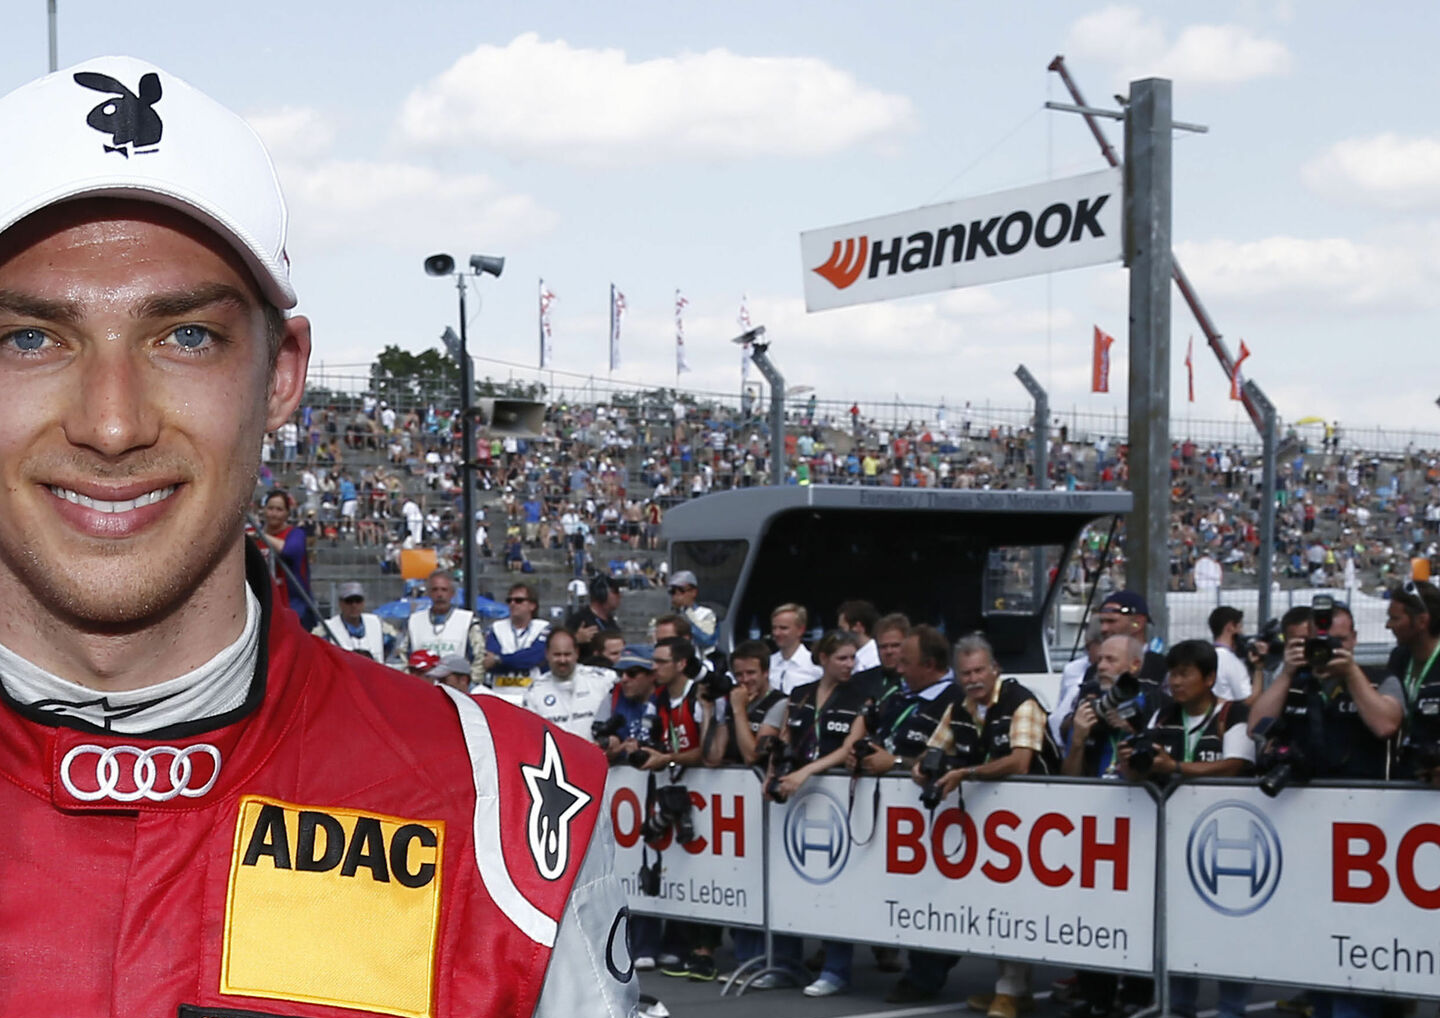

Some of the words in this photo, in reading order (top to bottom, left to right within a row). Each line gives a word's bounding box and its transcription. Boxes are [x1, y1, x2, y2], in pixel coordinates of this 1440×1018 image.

[242, 801, 438, 889] ADAC
[886, 806, 1130, 892] BOSCH
[690, 879, 747, 907] Leben
[885, 900, 980, 936] Technik
[987, 907, 1037, 942] fürs
[1045, 915, 1128, 950] Leben
